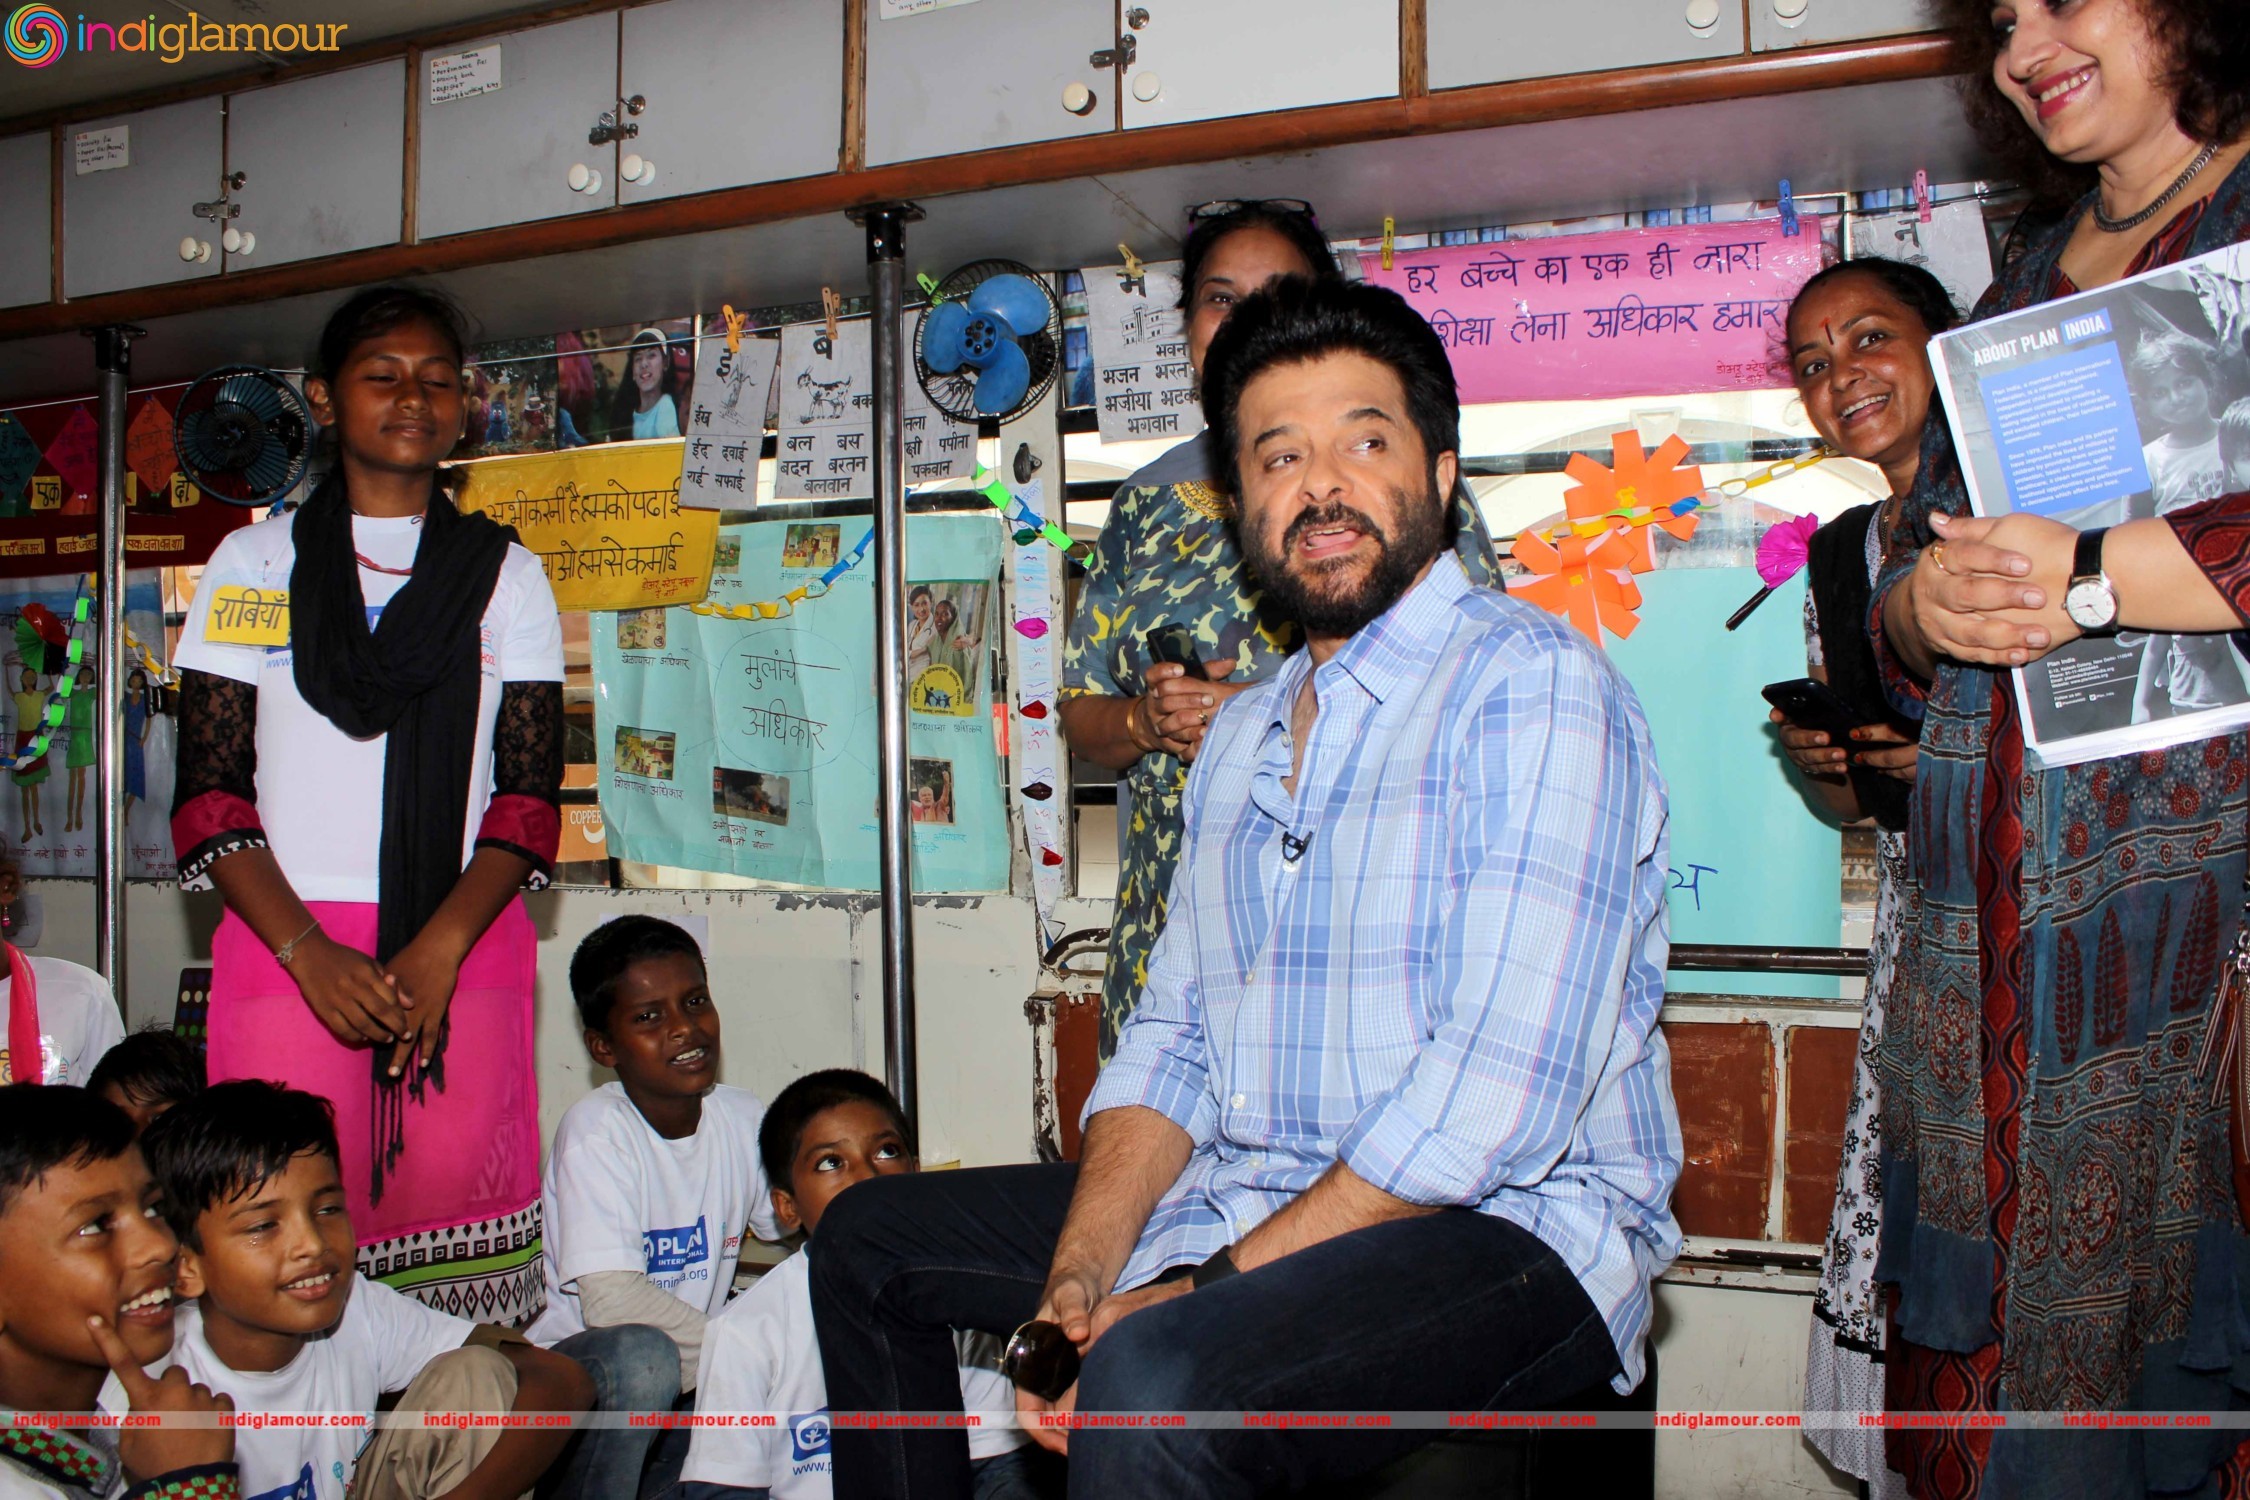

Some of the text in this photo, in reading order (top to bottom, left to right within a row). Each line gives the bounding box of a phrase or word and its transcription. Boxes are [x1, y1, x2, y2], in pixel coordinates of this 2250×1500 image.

[1404, 265, 1440, 293] हर
[1460, 252, 1526, 288] बच्चे
[1535, 256, 1573, 285] का
[1580, 253, 1629, 281] एक
[1647, 243, 1681, 281] ही
[1510, 303, 1571, 343] लेना
[1584, 294, 1704, 341] अधिकार
[1156, 342, 1190, 357] भवन
[1974, 315, 2106, 367] ABOUT PLAN INDIA
[1103, 362, 1190, 384] भजन भरत
[1105, 388, 1152, 412] भजीया
[694, 405, 712, 427] ईख
[903, 416, 926, 431] तला
[1128, 414, 1179, 433] भगवान
[691, 438, 749, 463] ईद दवाई
[786, 432, 864, 451] बल बस
[939, 431, 970, 452] पपीता
[780, 456, 868, 477] बदन बरतन
[911, 460, 952, 478] पकवान
[687, 465, 747, 493] राई सफाई
[804, 477, 852, 493] बलवान
[741, 649, 840, 690] मुलांचे
[741, 698, 828, 751] अधिकार
[658, 1227, 703, 1256] PLAN
